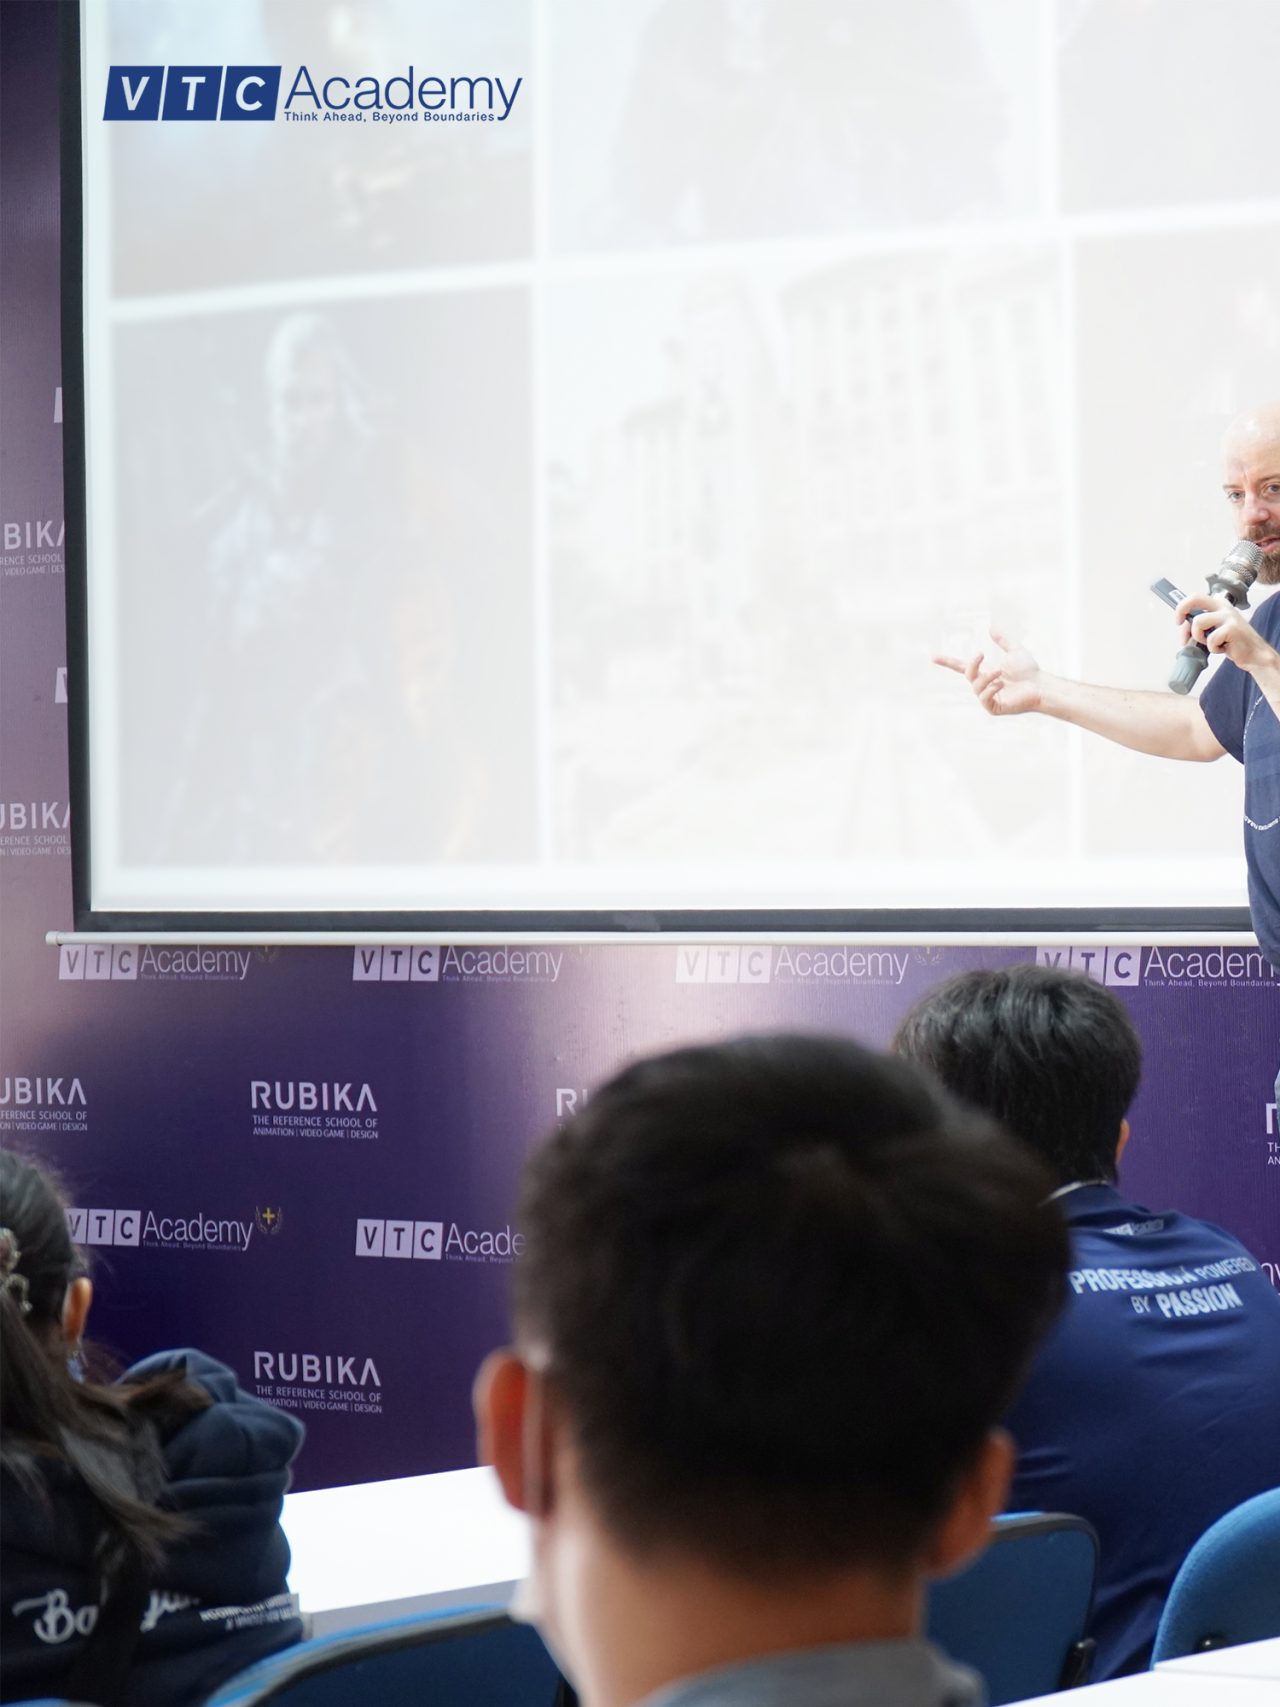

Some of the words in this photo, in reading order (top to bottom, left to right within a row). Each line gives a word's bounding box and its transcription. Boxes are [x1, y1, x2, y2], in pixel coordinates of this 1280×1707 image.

[63, 948, 134, 976] VTC
[140, 944, 251, 981] Academy
[359, 948, 435, 977] VTC
[442, 945, 563, 982] Academy
[681, 949, 767, 979] VTC
[774, 946, 909, 985] Academy
[1230, 979, 1275, 987] Boundaries
[250, 1080, 378, 1112] RUBIKA
[39, 1110, 73, 1121] SCHOOL
[75, 1111, 88, 1121] OF
[252, 1114, 270, 1126] THE
[273, 1115, 322, 1127] REFERENCE
[325, 1116, 362, 1128] SCHOOL
[365, 1118, 378, 1129] OF
[142, 1210, 254, 1252] Academy
[361, 1223, 438, 1254] VTC
[445, 1222, 527, 1256] Acade
[1131, 1295, 1151, 1314] BY
[1155, 1283, 1244, 1319] PASSION
[254, 1351, 381, 1387] RUBIKA
[256, 1385, 273, 1396] THE
[276, 1386, 326, 1400] REFERENCE
[329, 1389, 366, 1402] SCHOOL
[369, 1392, 382, 1403] OF
